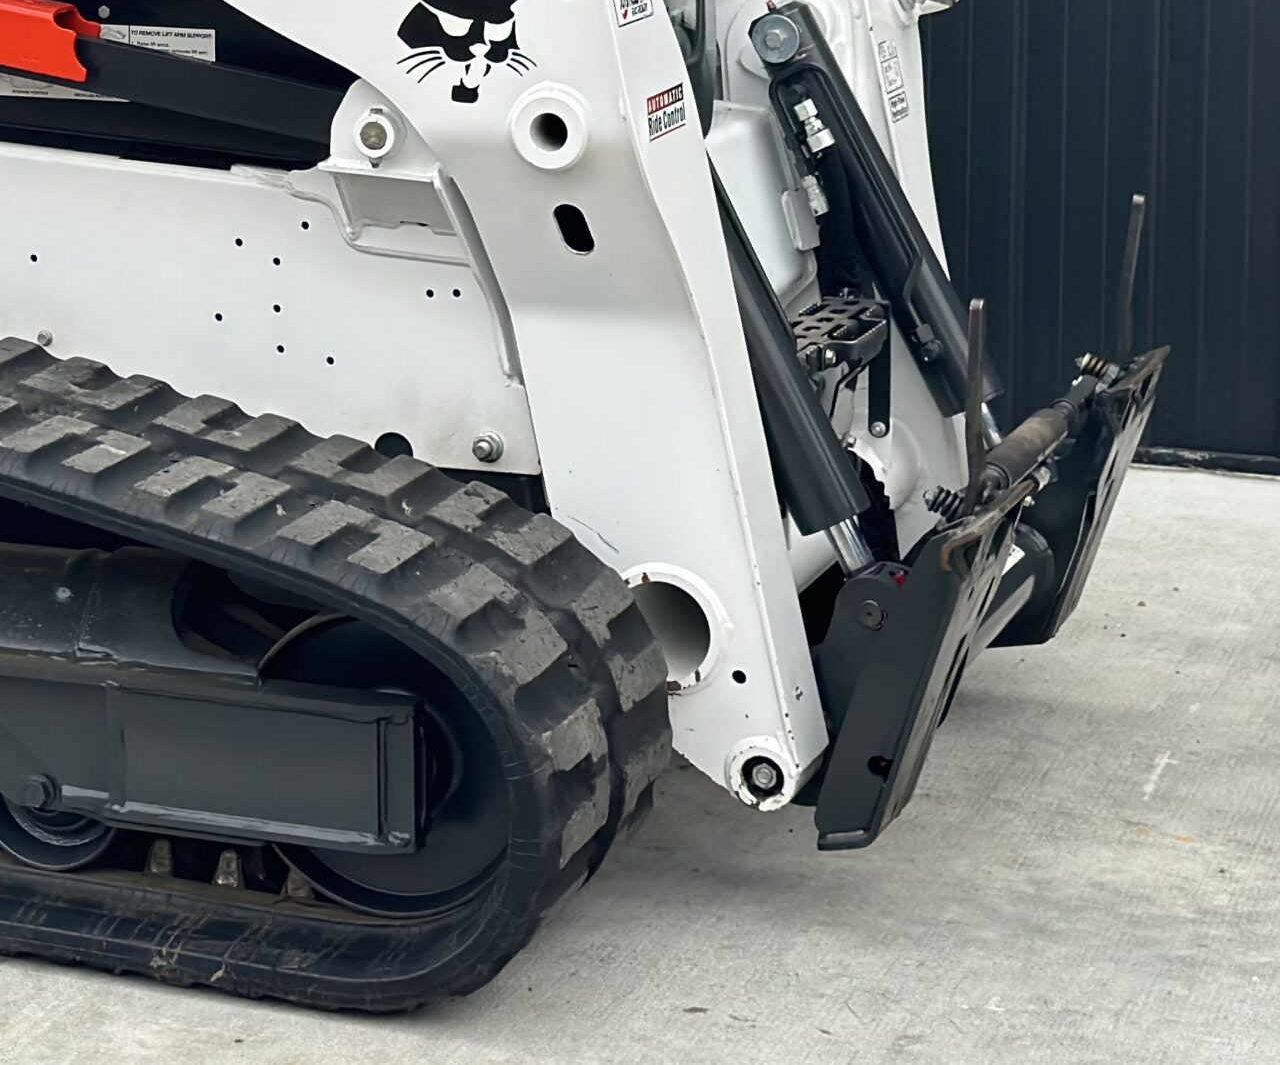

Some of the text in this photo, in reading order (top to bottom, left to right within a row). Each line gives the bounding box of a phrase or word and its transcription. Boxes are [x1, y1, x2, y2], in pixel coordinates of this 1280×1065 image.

[648, 85, 683, 114] AUTOMATIC
[648, 101, 686, 136] Ride Control
